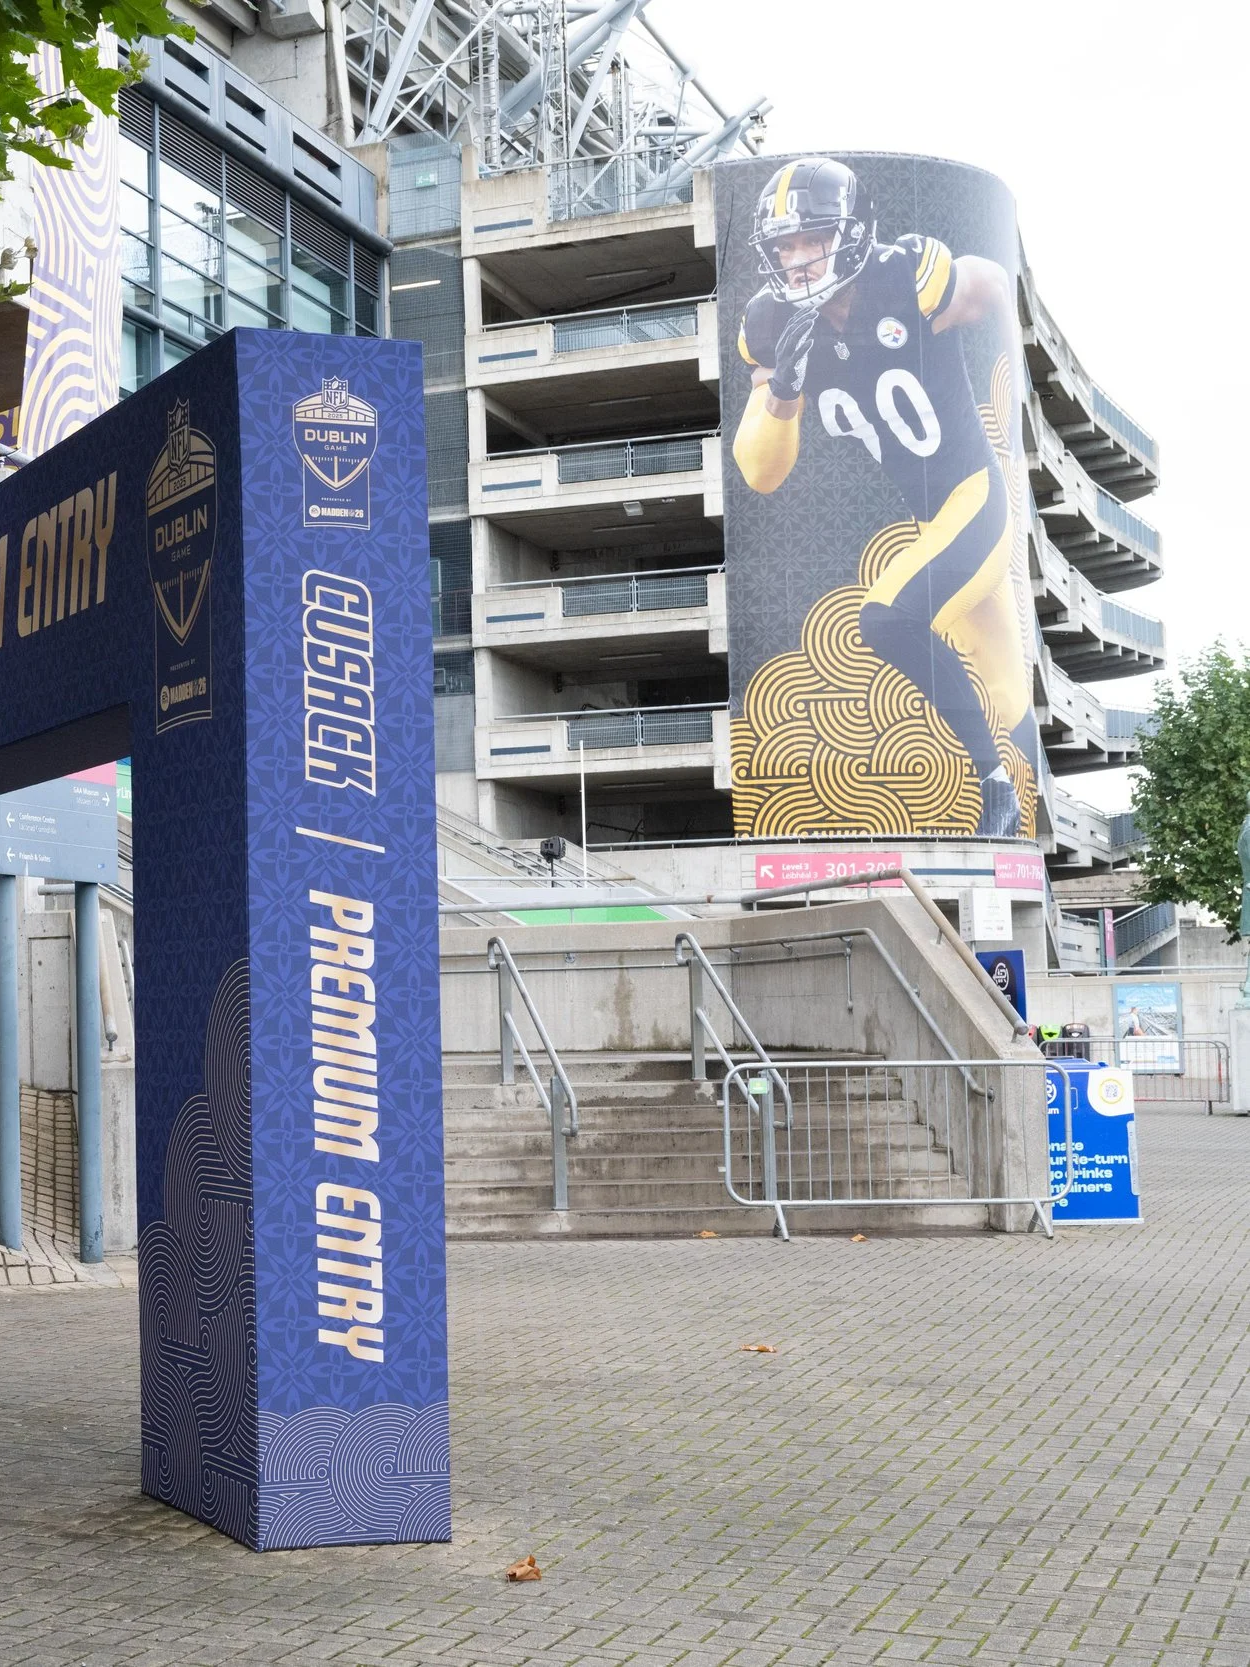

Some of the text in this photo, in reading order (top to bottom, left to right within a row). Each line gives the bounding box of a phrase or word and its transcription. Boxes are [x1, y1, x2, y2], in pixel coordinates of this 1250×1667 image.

[324, 391, 346, 405] NFL
[818, 369, 941, 464] 90
[304, 428, 367, 445] DUBLIN
[170, 432, 189, 461] NFL
[324, 444, 348, 452] GAME
[173, 478, 187, 492] 2025
[354, 508, 364, 518] 26
[155, 504, 208, 553] DUBLIN
[17, 470, 118, 638] ENTRY
[171, 544, 191, 562] GAME
[170, 680, 194, 704] MADDEN
[198, 676, 207, 696] 26
[19, 813, 55, 824] Conference Centre
[302, 569, 385, 1364] CUSACK PREMIUM ENTRY
[1072, 1153, 1128, 1165] Re-turn
